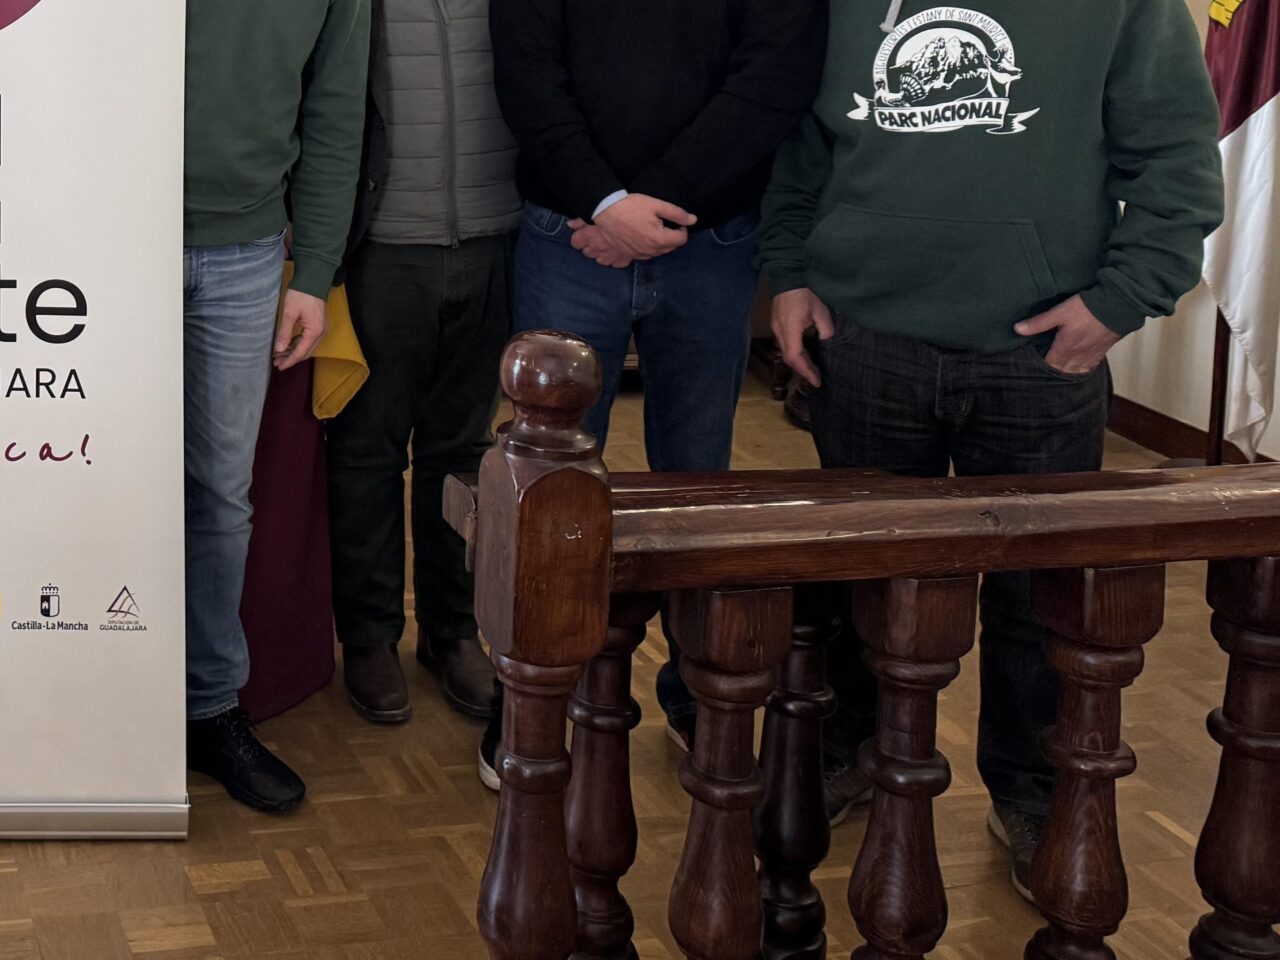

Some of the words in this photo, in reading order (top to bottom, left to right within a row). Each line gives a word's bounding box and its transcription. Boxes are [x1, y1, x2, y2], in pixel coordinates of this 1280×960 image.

[911, 9, 942, 27] ESTANY
[945, 9, 956, 20] DE
[959, 10, 979, 24] SANT
[976, 16, 1007, 44] MAURICI
[878, 111, 919, 129] PARC
[921, 102, 1003, 127] NACIONAL
[57, 621, 89, 631] Mancha
[99, 624, 148, 632] GUADALAJARA
